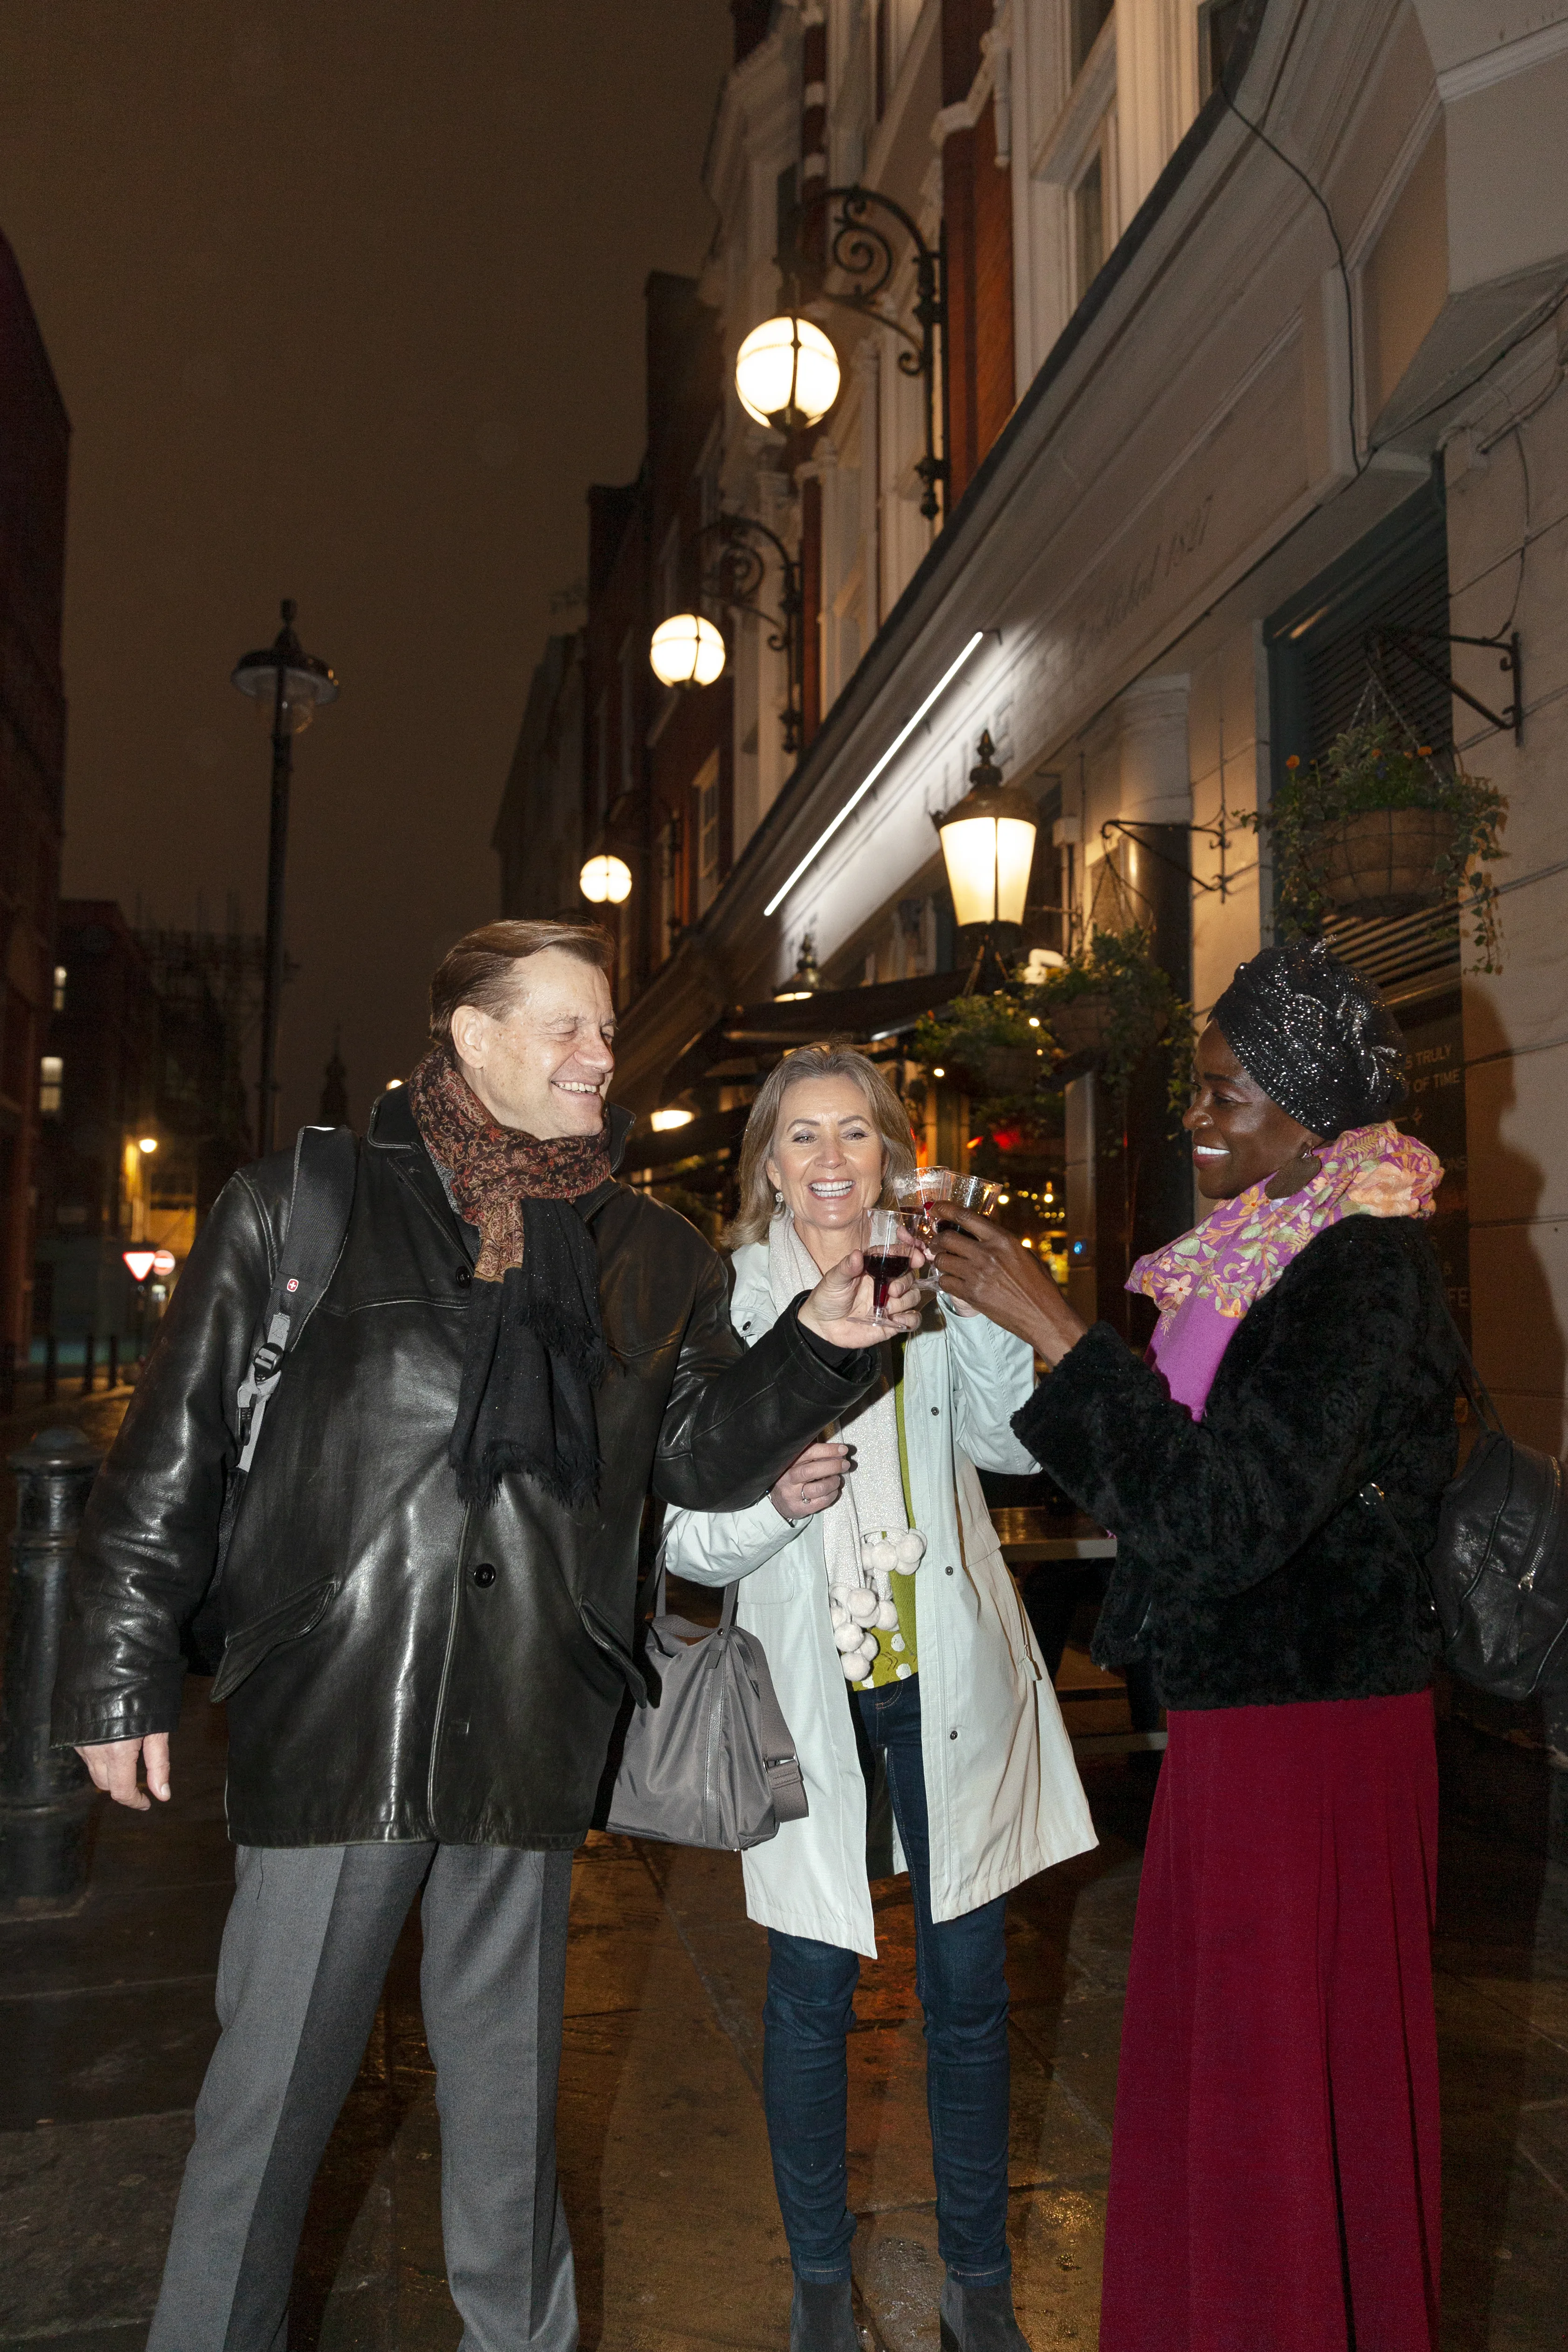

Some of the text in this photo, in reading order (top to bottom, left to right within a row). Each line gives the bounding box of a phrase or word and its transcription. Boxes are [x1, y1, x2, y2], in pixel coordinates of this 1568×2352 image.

[1415, 1043, 1451, 1066] TRULY
[1413, 1076, 1429, 1093] OF
[1433, 1068, 1461, 1088] TIME
